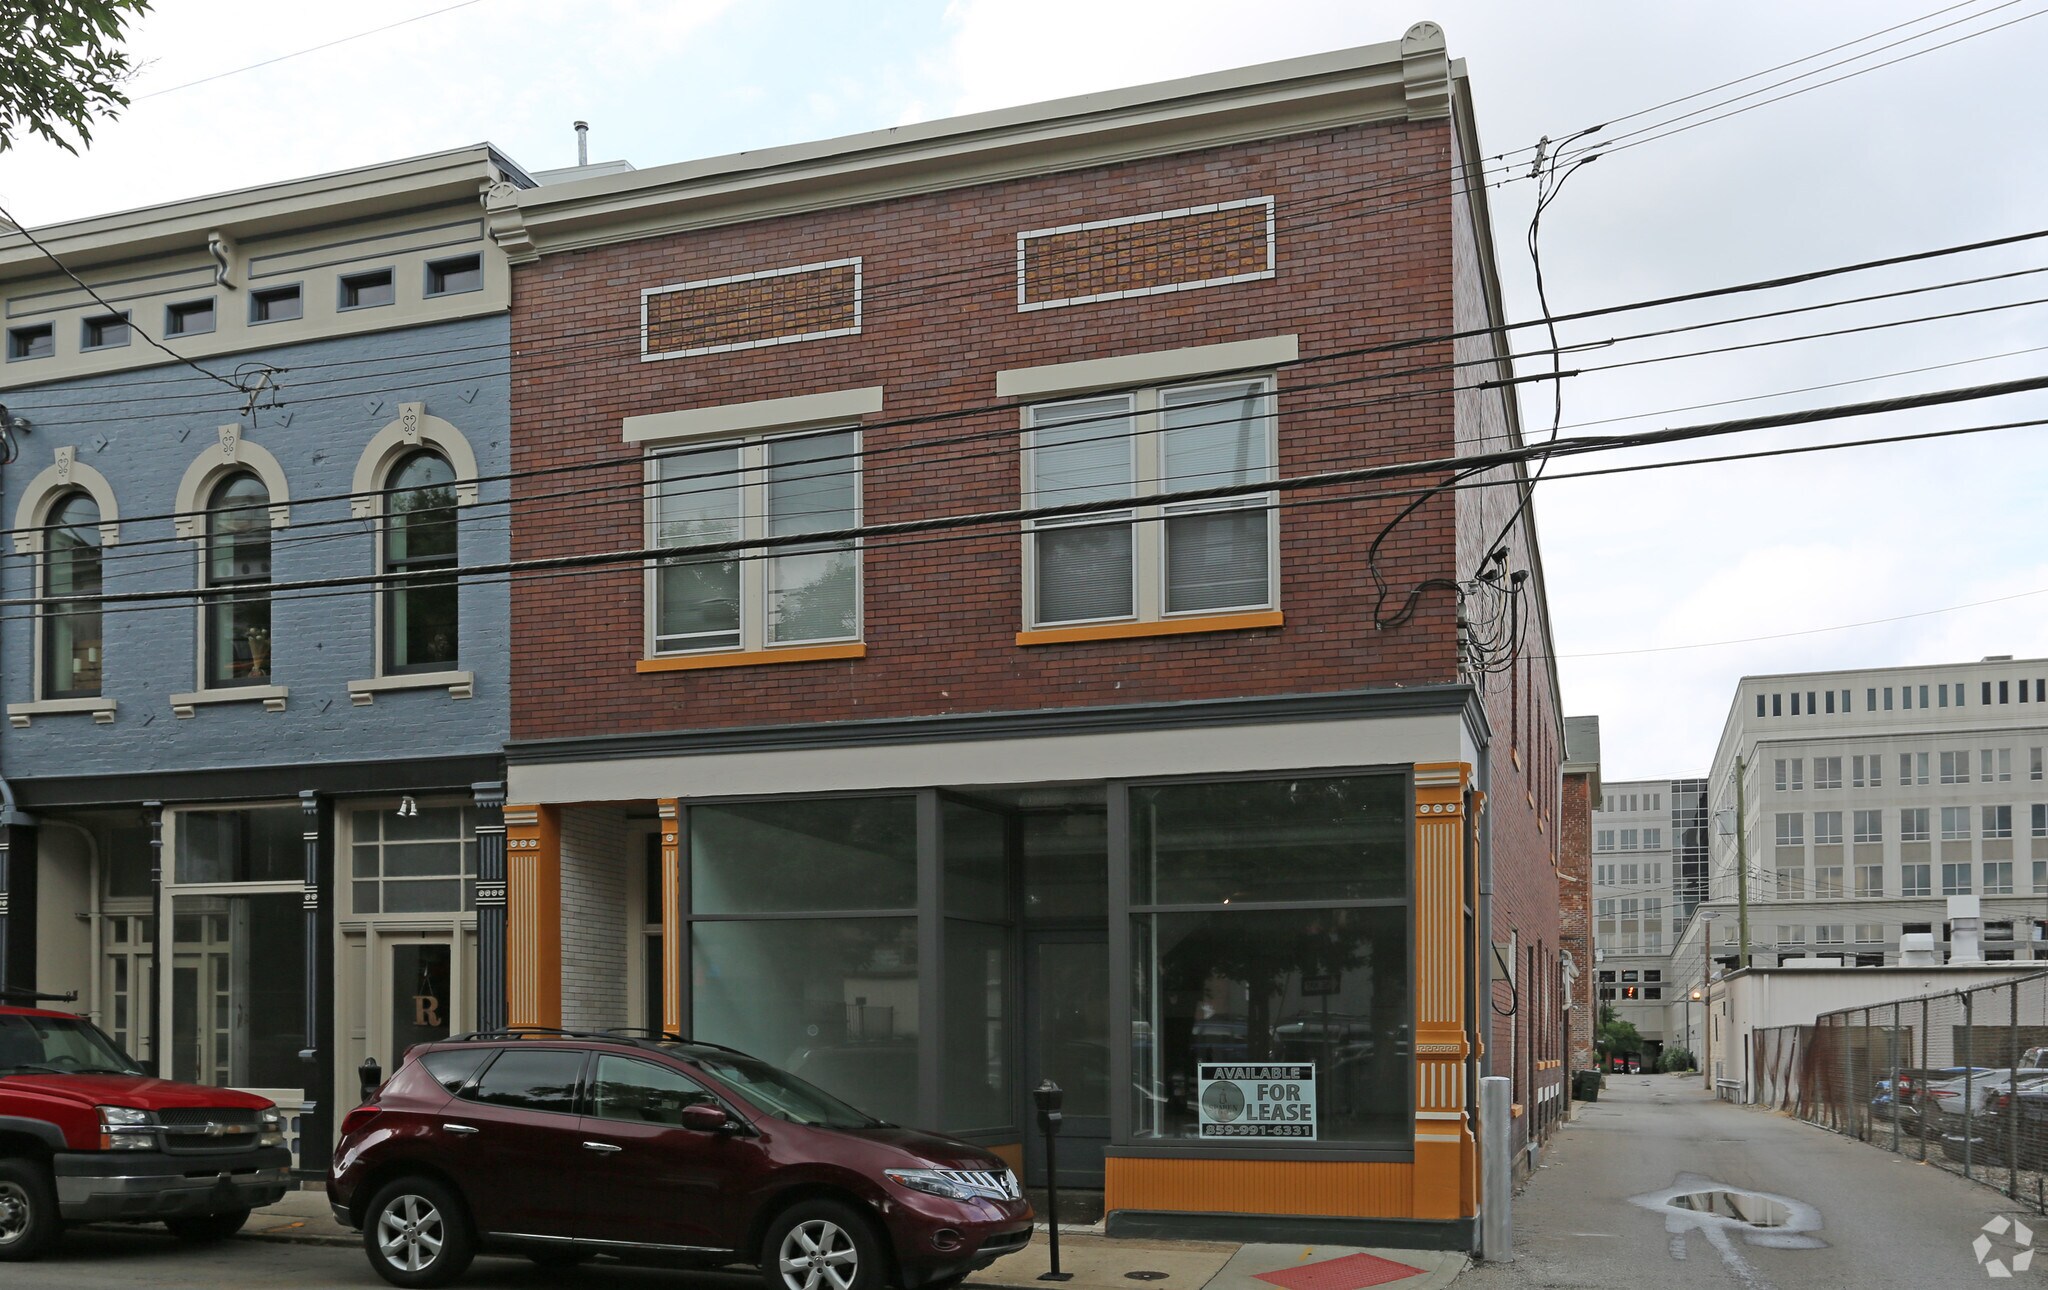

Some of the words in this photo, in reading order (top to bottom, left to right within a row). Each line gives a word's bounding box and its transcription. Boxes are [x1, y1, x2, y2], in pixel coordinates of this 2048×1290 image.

[412, 995, 441, 1027] R
[1213, 1067, 1301, 1079] AVAILABLE
[1257, 1084, 1301, 1101] FOR
[1246, 1103, 1312, 1121] LEASE
[1205, 1124, 1310, 1136] 859-991-6331
